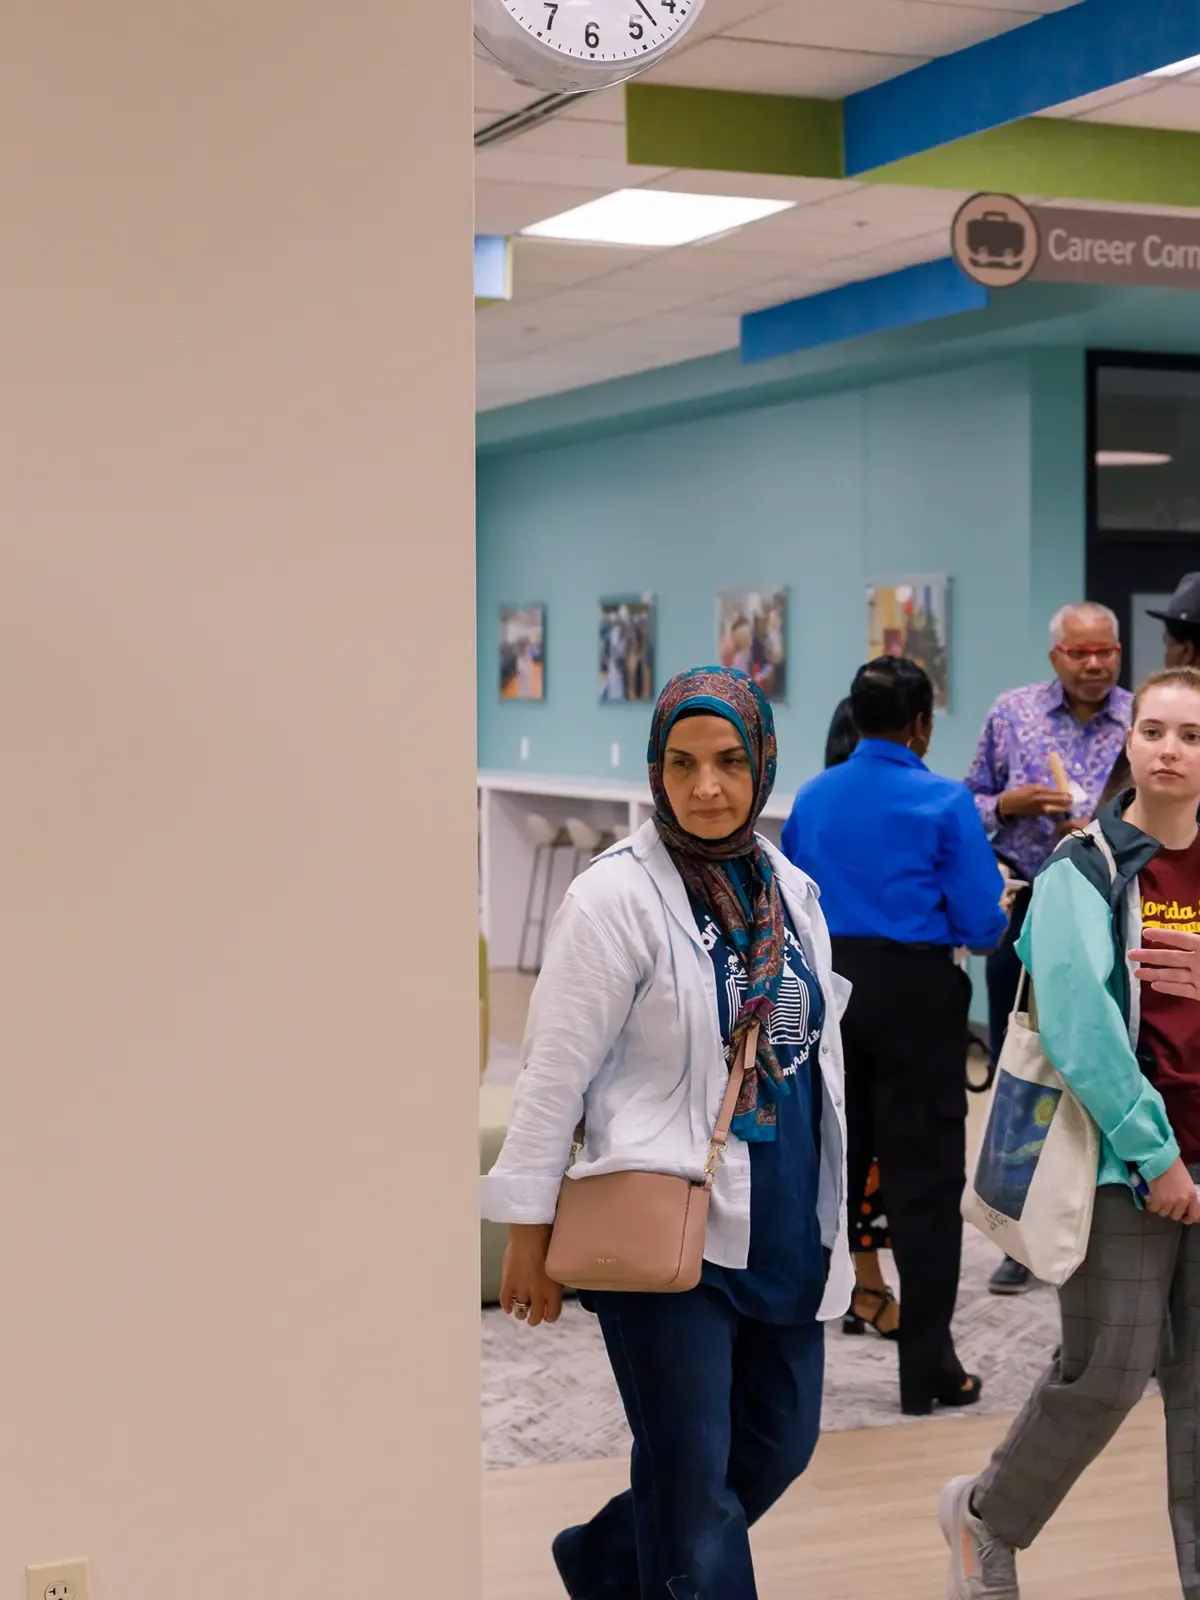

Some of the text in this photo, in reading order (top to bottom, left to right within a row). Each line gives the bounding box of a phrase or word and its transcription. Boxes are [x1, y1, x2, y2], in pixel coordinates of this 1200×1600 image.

[543, 2, 559, 31] 7
[628, 14, 644, 40] 5
[584, 21, 600, 49] 6
[1048, 228, 1136, 266] Career
